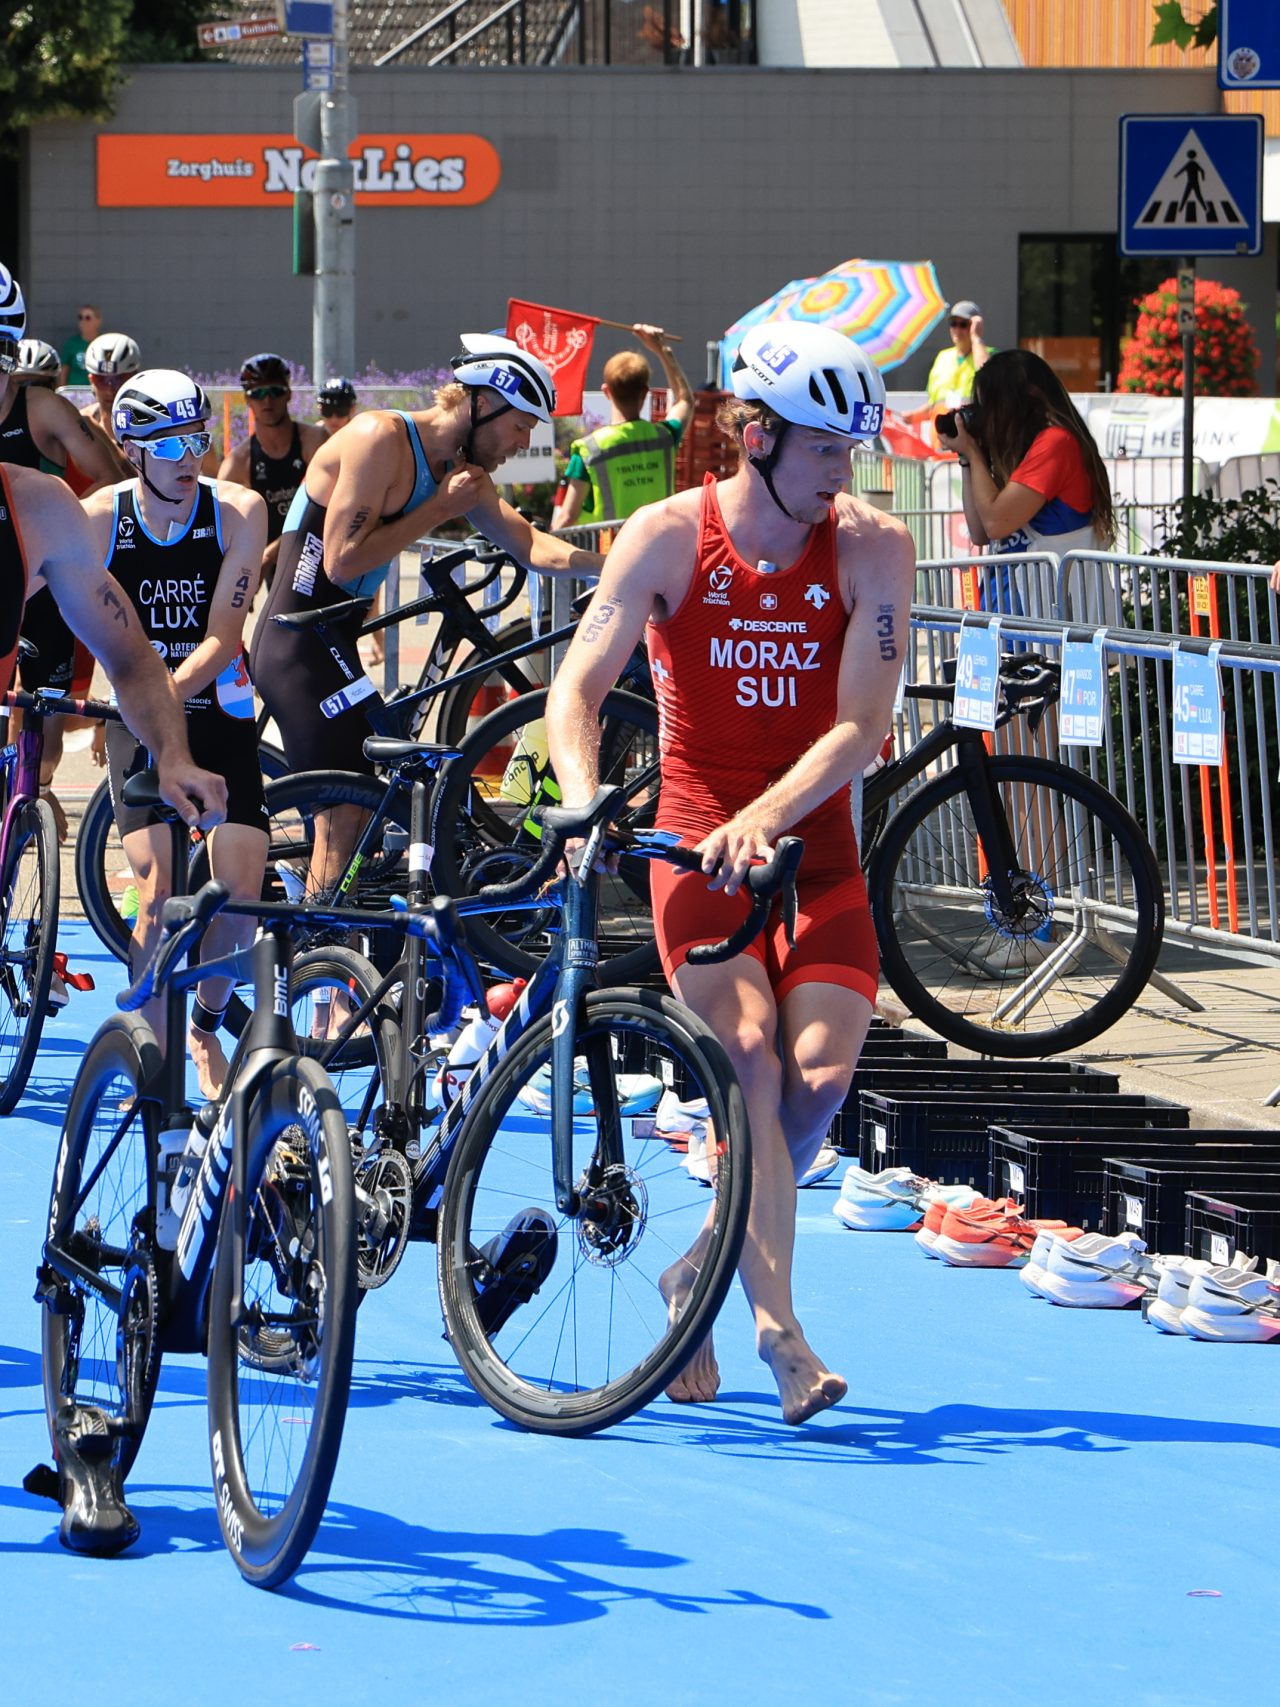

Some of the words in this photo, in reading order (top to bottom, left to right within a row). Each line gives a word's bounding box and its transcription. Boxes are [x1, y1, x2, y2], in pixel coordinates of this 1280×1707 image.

[167, 159, 253, 180] Zorghuis
[264, 144, 465, 192] NoLies
[495, 370, 515, 389] 57
[750, 363, 776, 386] SCOTT
[116, 412, 127, 429] 45
[176, 399, 196, 419] 45
[860, 405, 881, 431] 35
[1152, 431, 1241, 448] HEINK
[139, 572, 208, 605] CARRÉ
[231, 575, 250, 609] 45
[703, 597, 730, 606] Triathlon
[708, 591, 728, 600] World
[150, 606, 200, 629] LUX
[743, 619, 807, 633] DESCENTE
[329, 647, 355, 681] CUBE
[709, 637, 822, 671] MORAZ
[956, 653, 974, 689] 49
[735, 676, 797, 708] SUI
[1061, 669, 1076, 705] 47
[1083, 690, 1097, 706] POR
[325, 694, 345, 715] 57
[1174, 684, 1189, 723] 45
[340, 852, 364, 893] CUBE
[274, 964, 288, 1018] BMC
[220, 1482, 245, 1553] SWISS
